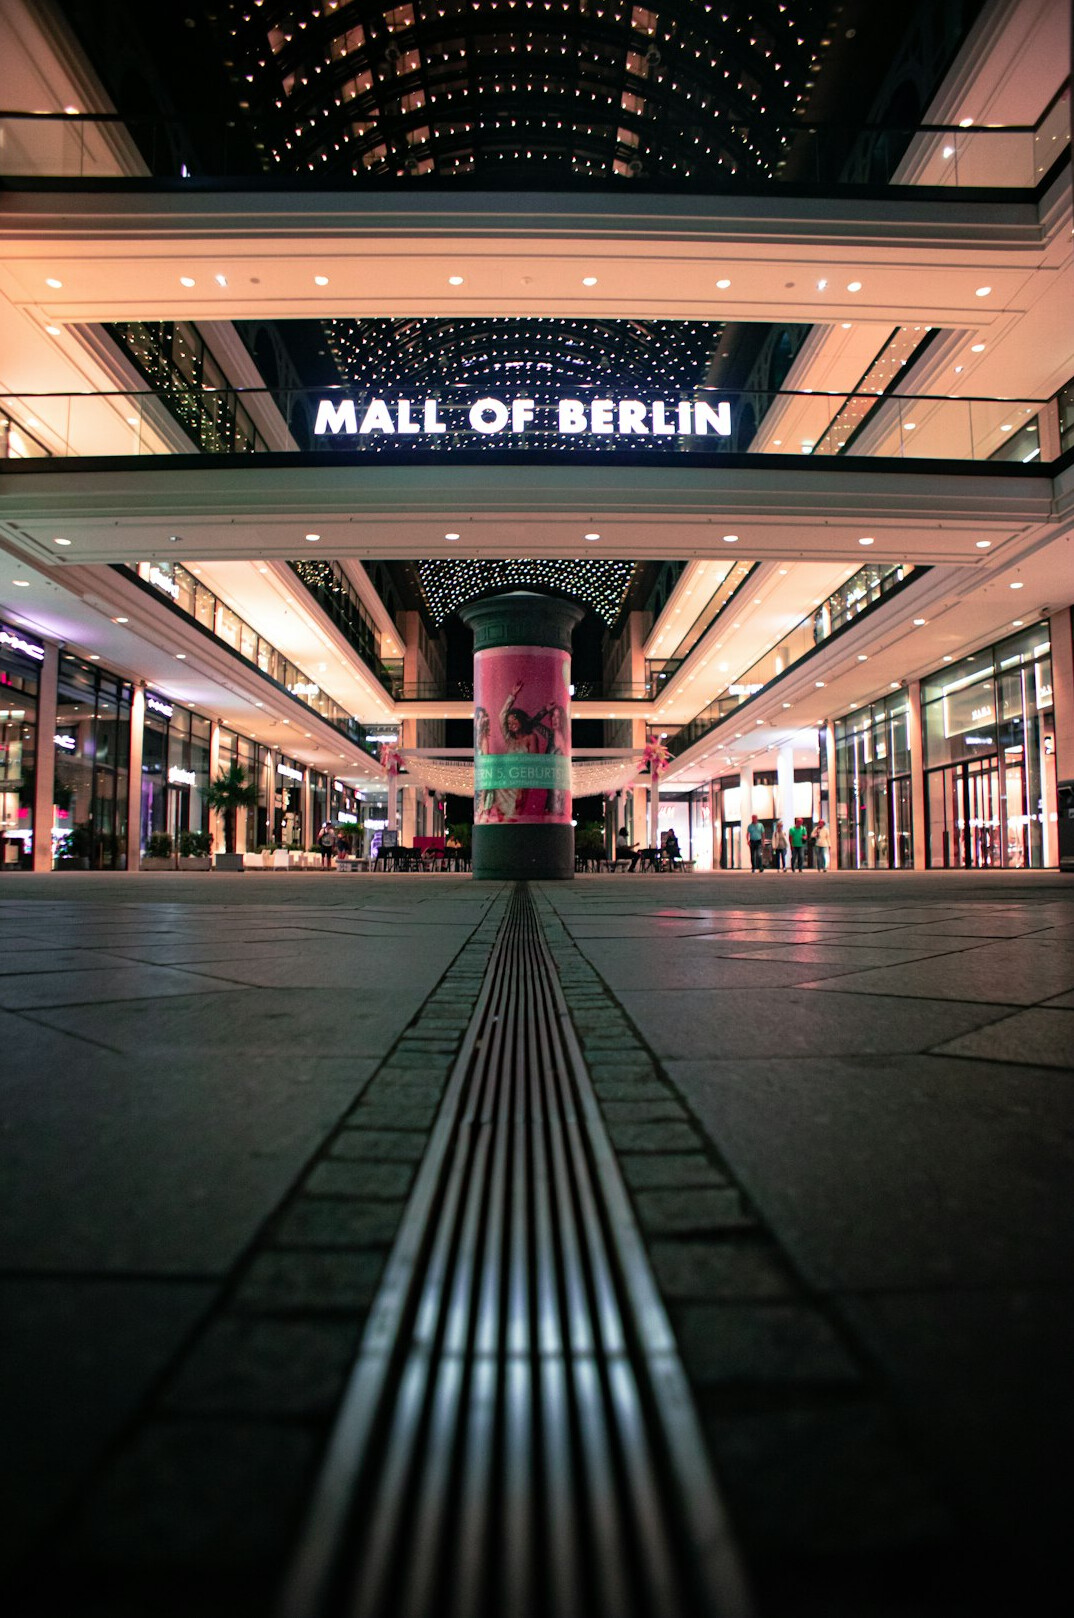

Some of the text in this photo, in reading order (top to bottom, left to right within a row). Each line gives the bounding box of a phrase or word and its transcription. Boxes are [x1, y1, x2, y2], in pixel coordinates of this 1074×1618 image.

[314, 397, 732, 436] MALL OF BERLIN
